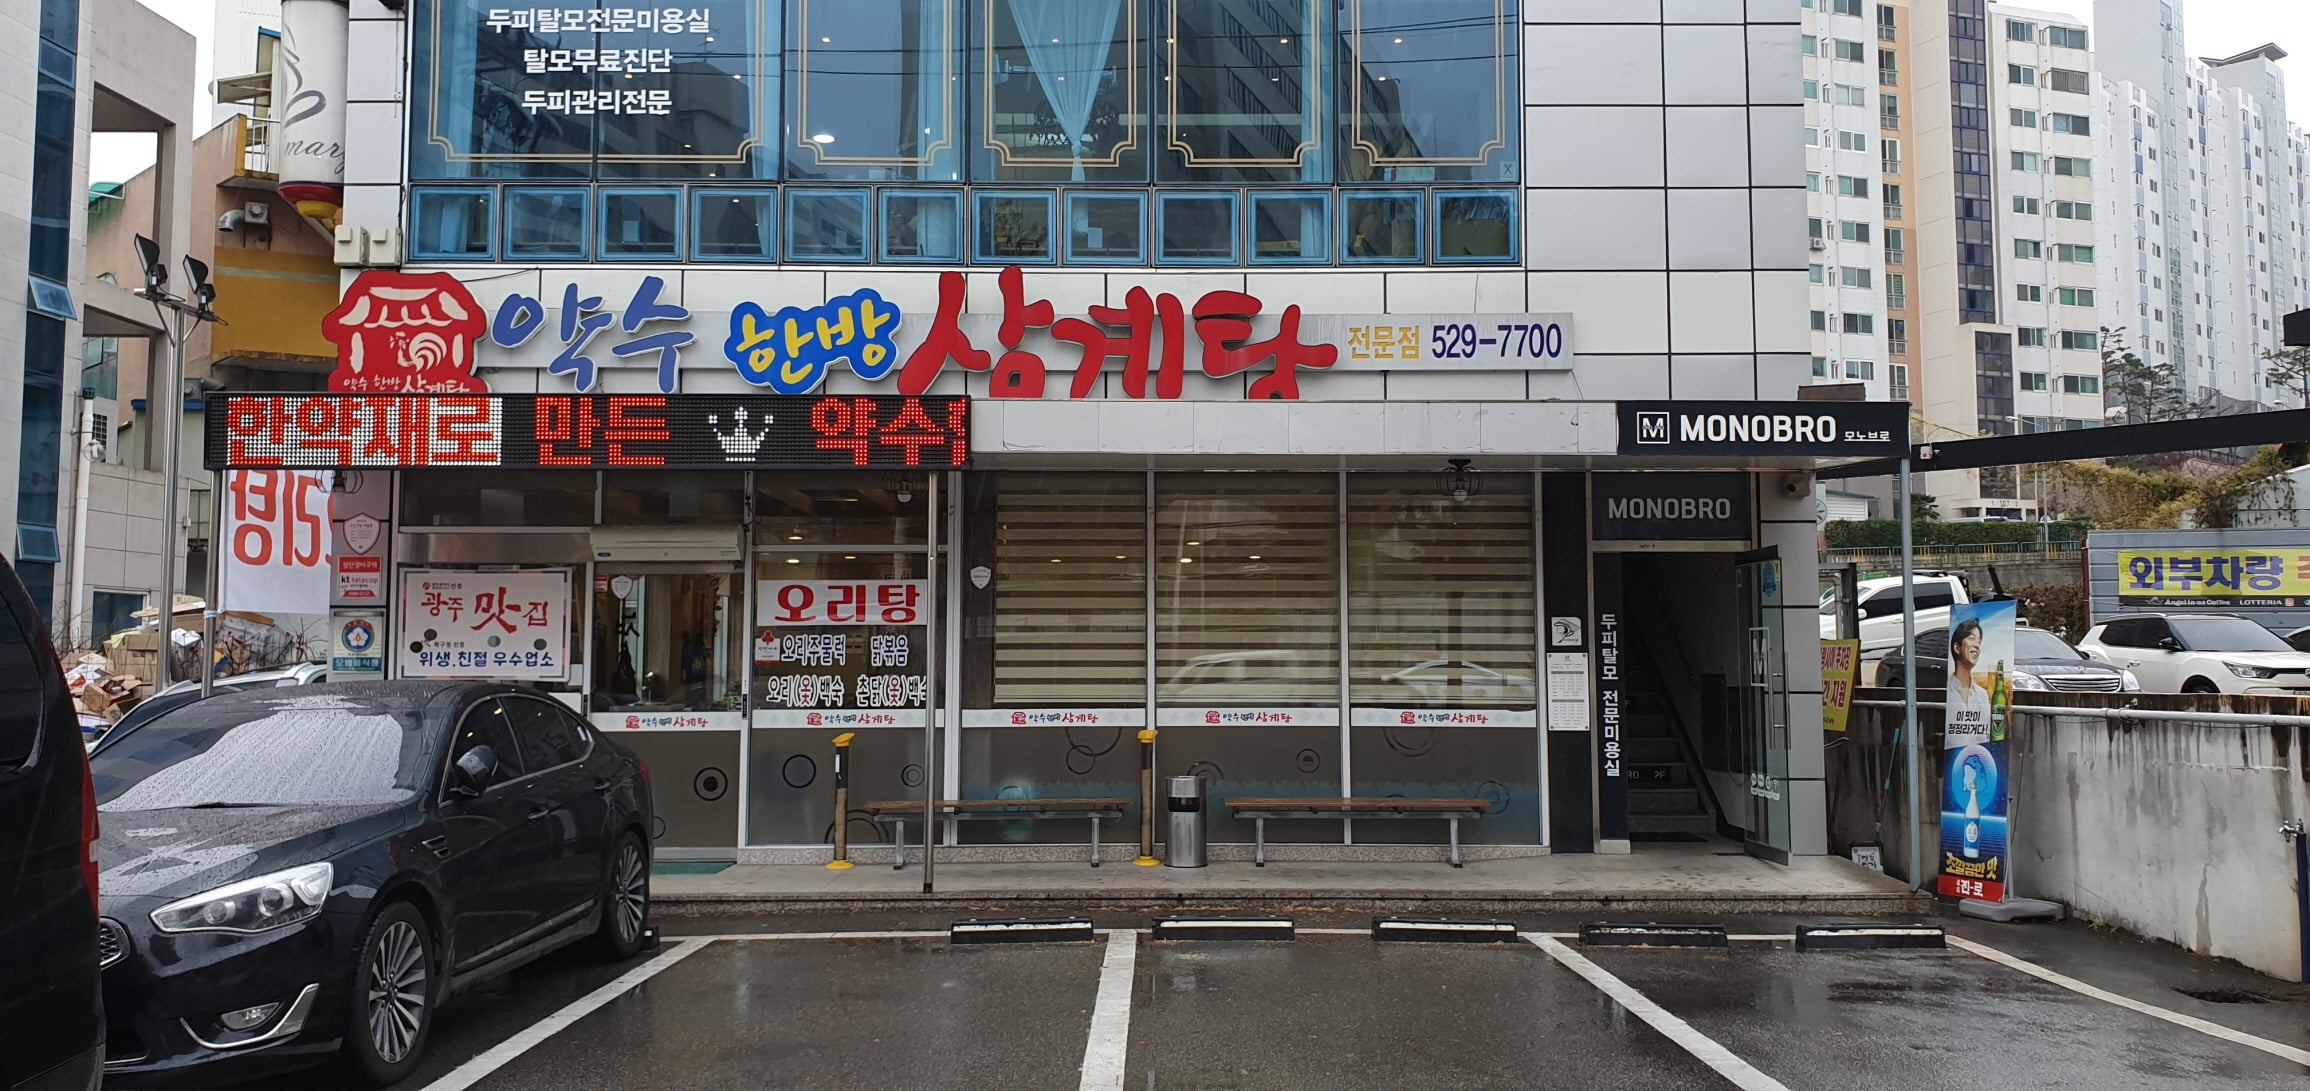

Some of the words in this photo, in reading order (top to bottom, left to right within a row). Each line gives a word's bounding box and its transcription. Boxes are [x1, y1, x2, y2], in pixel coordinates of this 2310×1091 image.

[486, 8, 711, 33] 두피탈모전문미용실
[523, 48, 673, 73] 탈모무료진단
[521, 90, 673, 115] 두피관리전문
[490, 275, 697, 393] 약수
[729, 292, 898, 390] 한방
[897, 264, 1339, 398] 삼계탕
[1348, 325, 1420, 360] 전문점
[1431, 323, 1563, 359] 529-7700
[343, 376, 367, 391] 약수
[226, 396, 502, 465] 한약재로
[533, 396, 670, 465] 만든
[810, 396, 967, 465] 약수
[1680, 414, 1838, 442] MONOBRO
[1844, 431, 1892, 442] 모노브로
[1608, 498, 1731, 519] MONOBRO
[2128, 555, 2284, 592] 외부차량
[420, 592, 464, 624] 광주
[774, 584, 921, 624] 오리탕
[493, 651, 555, 668] 우수업소
[781, 634, 846, 666] 오리주물럭
[871, 634, 909, 667] 닭볶음
[1600, 613, 1620, 681] 두피탈모
[1964, 710, 1981, 722] 맛이
[1602, 689, 1622, 778] 전문미용실
[1986, 855, 1998, 881] 맛
